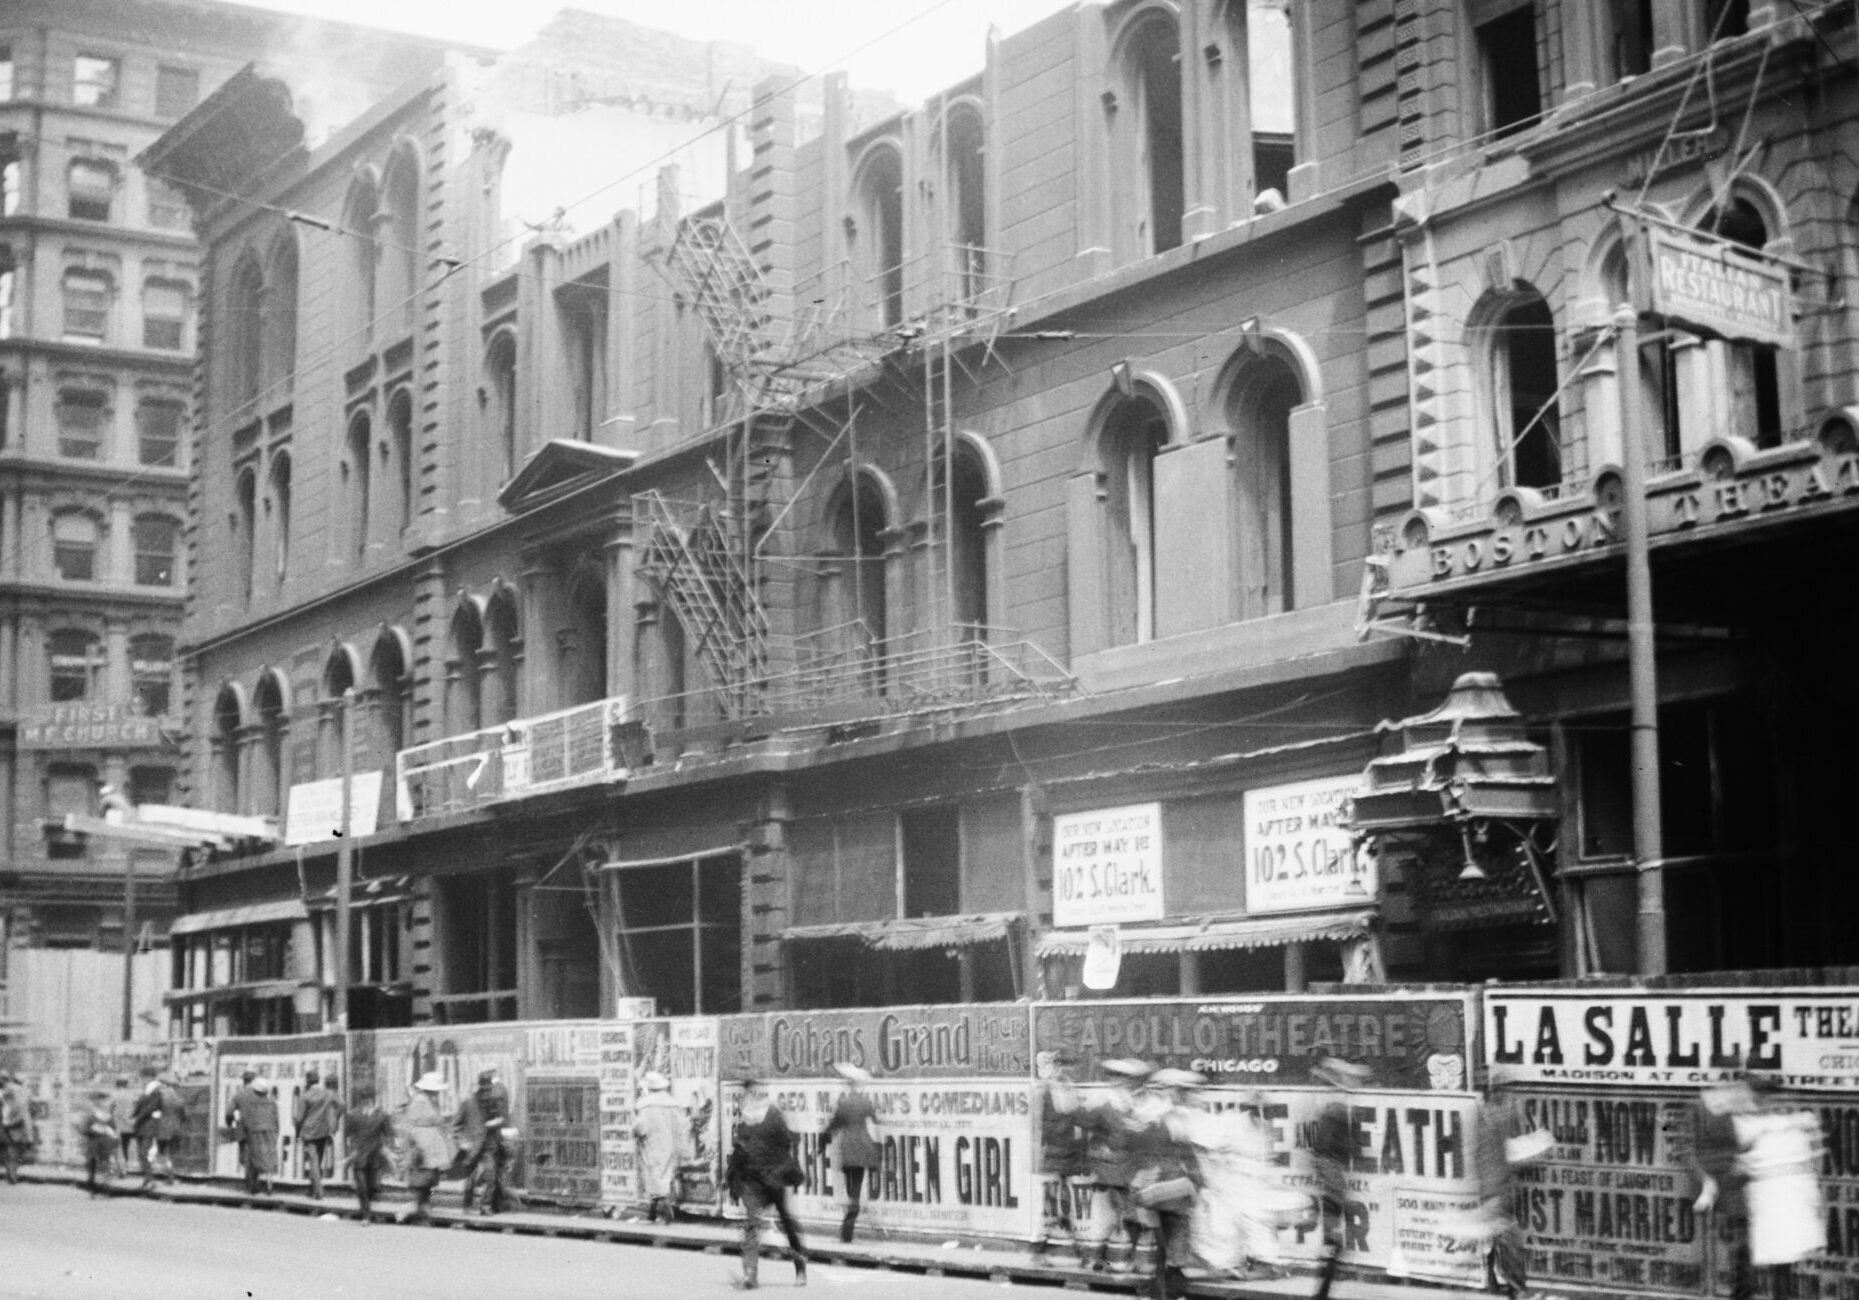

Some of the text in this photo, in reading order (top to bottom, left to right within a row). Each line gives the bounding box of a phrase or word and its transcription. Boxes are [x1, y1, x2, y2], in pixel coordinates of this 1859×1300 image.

[1659, 255, 1781, 321] RESTAURANT
[1680, 253, 1761, 289] ITALIAN
[1430, 509, 1624, 582] BOSTON
[55, 706, 118, 722] FIRST
[64, 724, 149, 742] CHURCH
[1258, 815, 1303, 836] AFTER
[1062, 841, 1098, 857] AFTER
[1103, 837, 1128, 854] MAY
[1254, 843, 1289, 884] 102
[1059, 866, 1084, 900] 102
[878, 1013, 971, 1073] Grand
[1080, 1013, 1407, 1058] APOLLO THEATRE
[1493, 1005, 1564, 1065] LA
[1583, 1004, 1783, 1071] SALLE
[1190, 1057, 1280, 1073] CHICAGO
[1540, 1068, 1636, 1081] MADISON
[1648, 1070, 1673, 1083] AT
[1687, 1071, 1756, 1084] CLAR
[919, 1091, 1029, 1116] COMEDIANS
[1593, 1100, 1657, 1165] NOW
[955, 1135, 1019, 1209] GIRL
[1561, 1168, 1595, 1187] FEAST
[1600, 1171, 1613, 1188] OF
[1616, 1172, 1675, 1193] LAUGHTER
[1574, 1189, 1696, 1244] MARRIED
